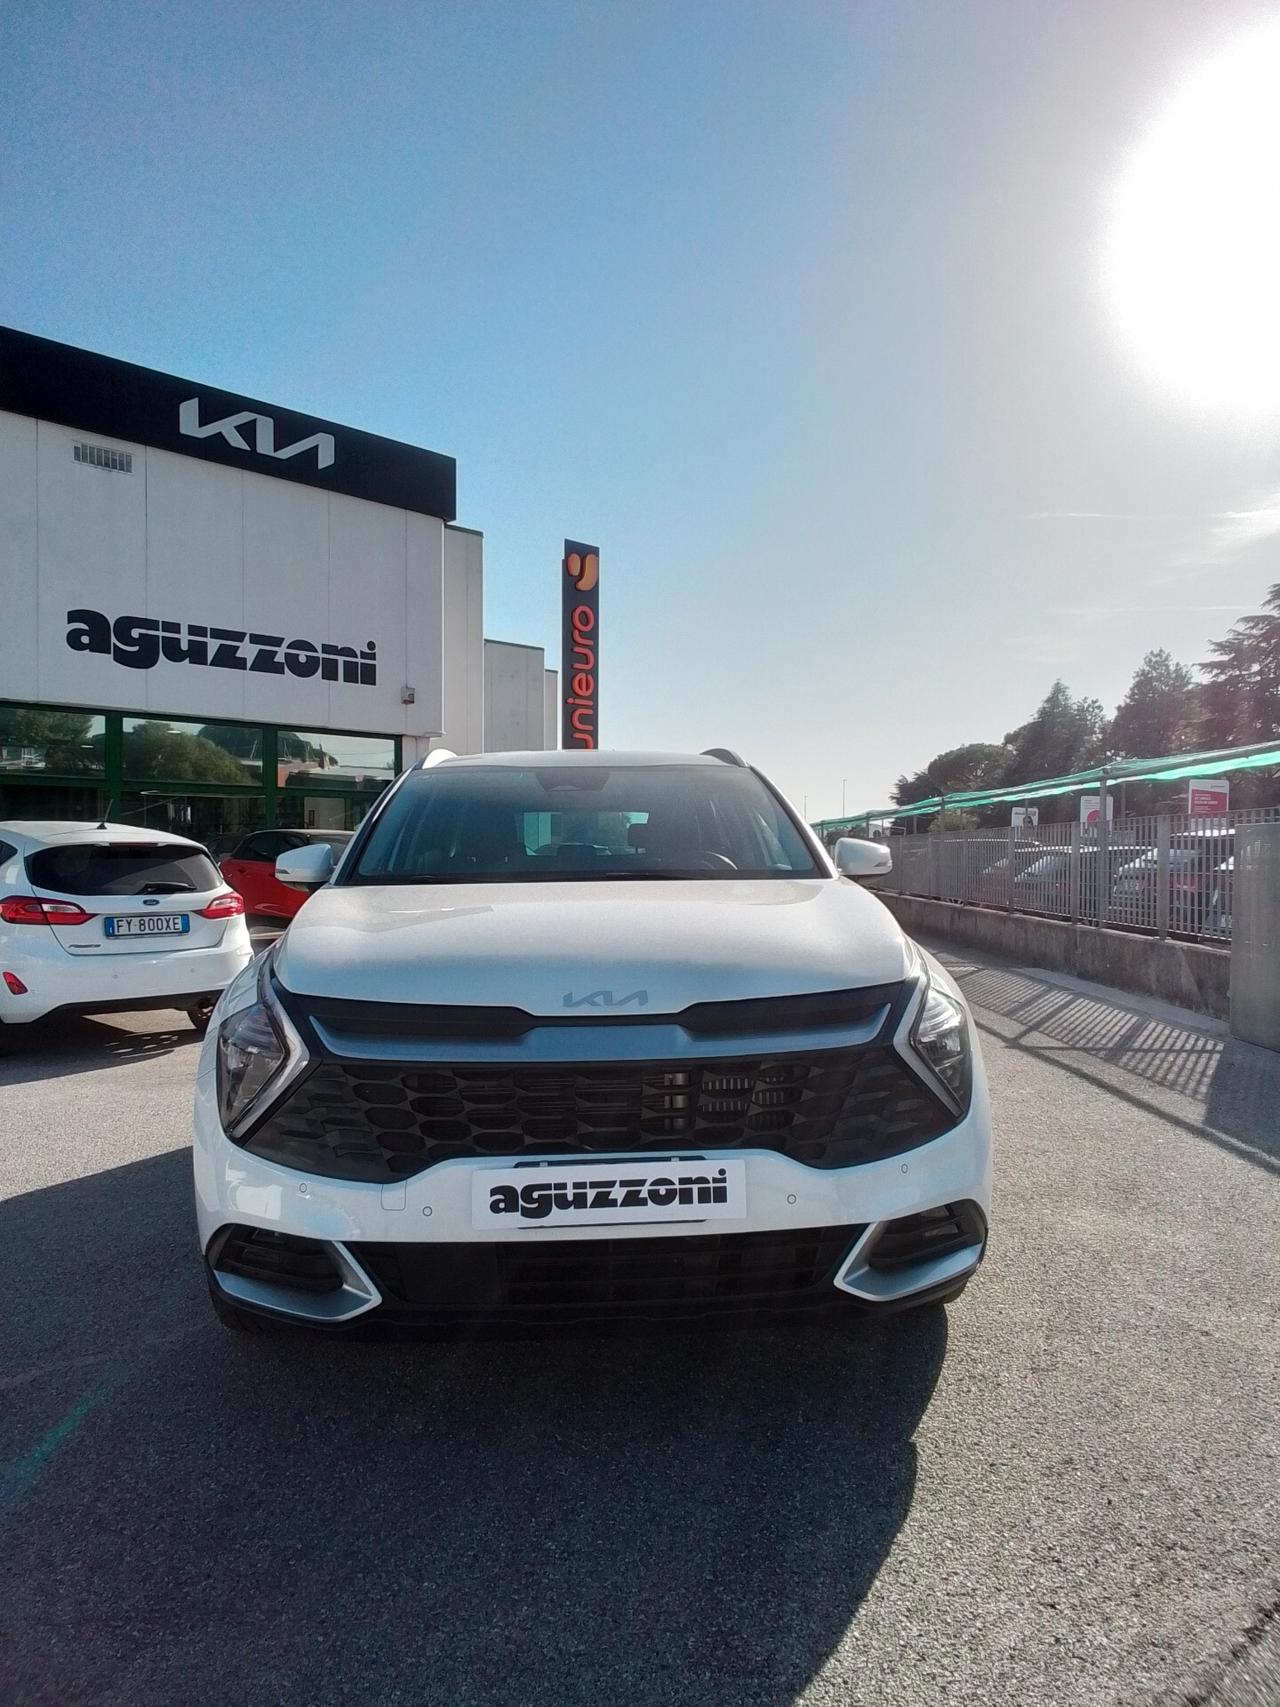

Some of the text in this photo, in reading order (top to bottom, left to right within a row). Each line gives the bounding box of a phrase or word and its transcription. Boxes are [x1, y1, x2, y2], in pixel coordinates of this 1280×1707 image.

[179, 397, 335, 470] KIA
[66, 608, 377, 686] aguzzoni
[116, 918, 180, 934] FY 800XE
[489, 1168, 728, 1219] aguzzoni
